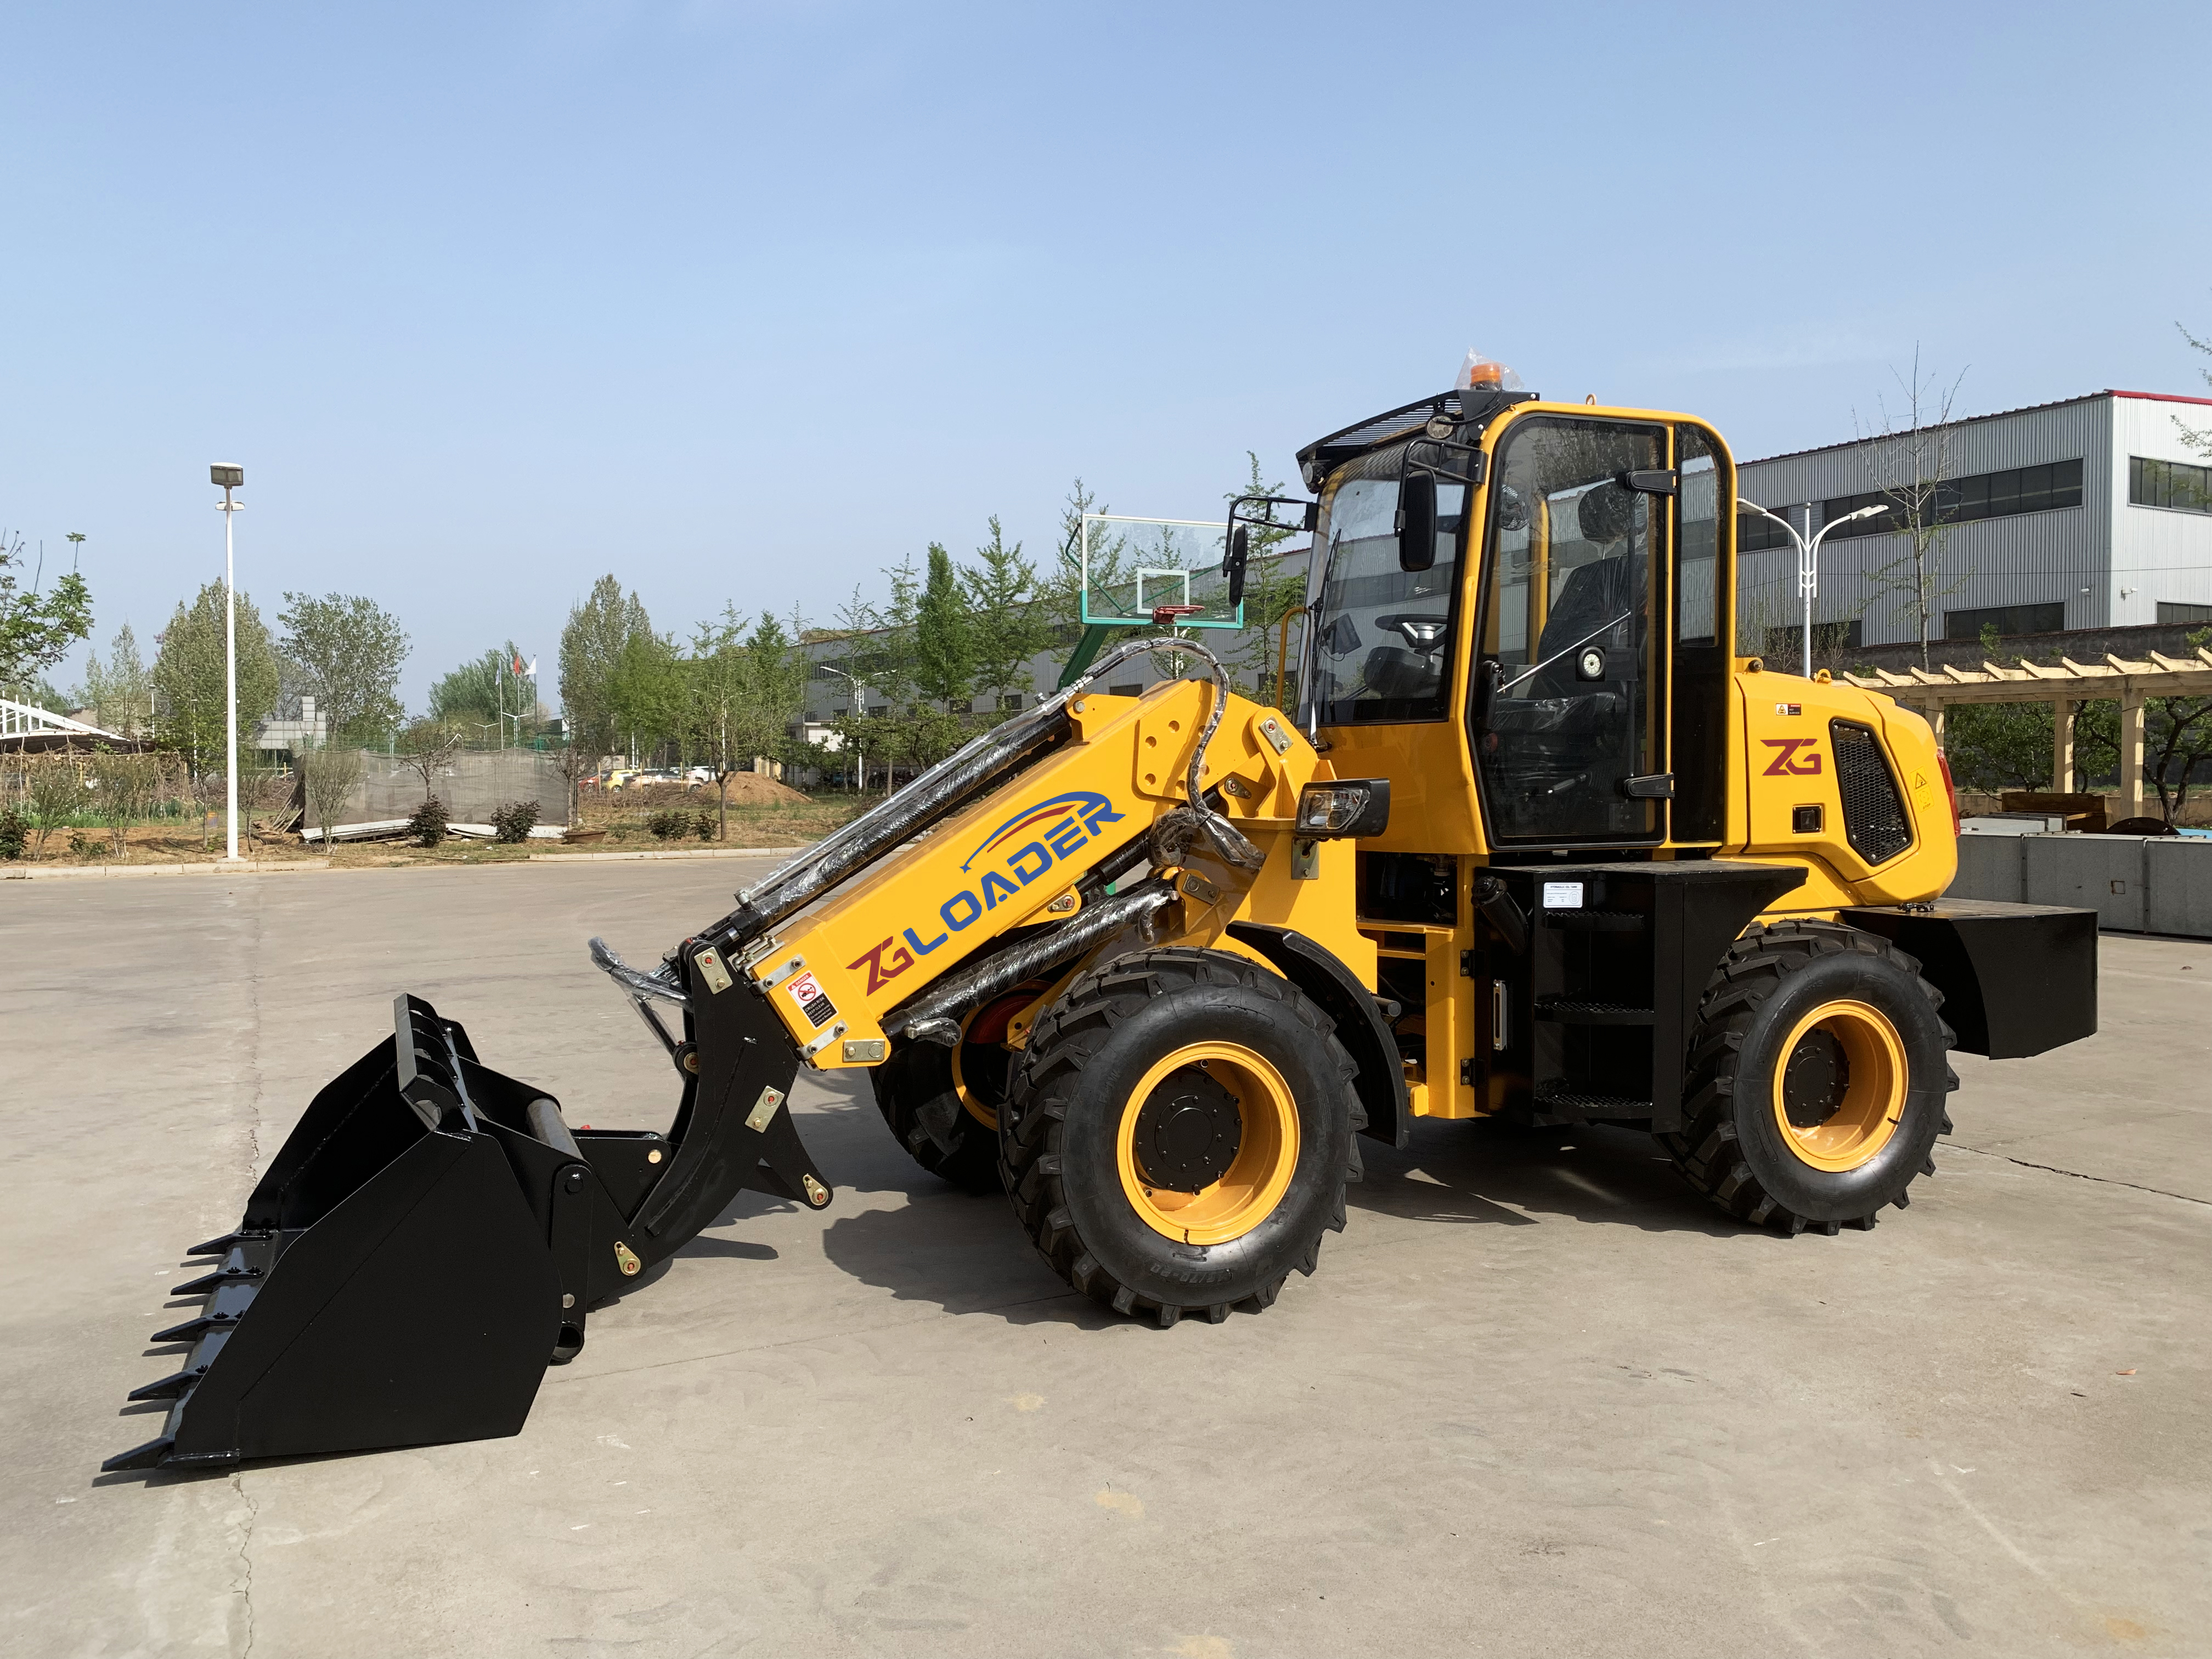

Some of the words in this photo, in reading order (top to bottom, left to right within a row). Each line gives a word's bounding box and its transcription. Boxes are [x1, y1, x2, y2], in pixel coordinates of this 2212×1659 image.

[1760, 738, 1822, 776] ZG
[795, 974, 809, 986] DANGER
[805, 1001, 817, 1012] CRUSH
[815, 1002, 825, 1011] CLEAR
